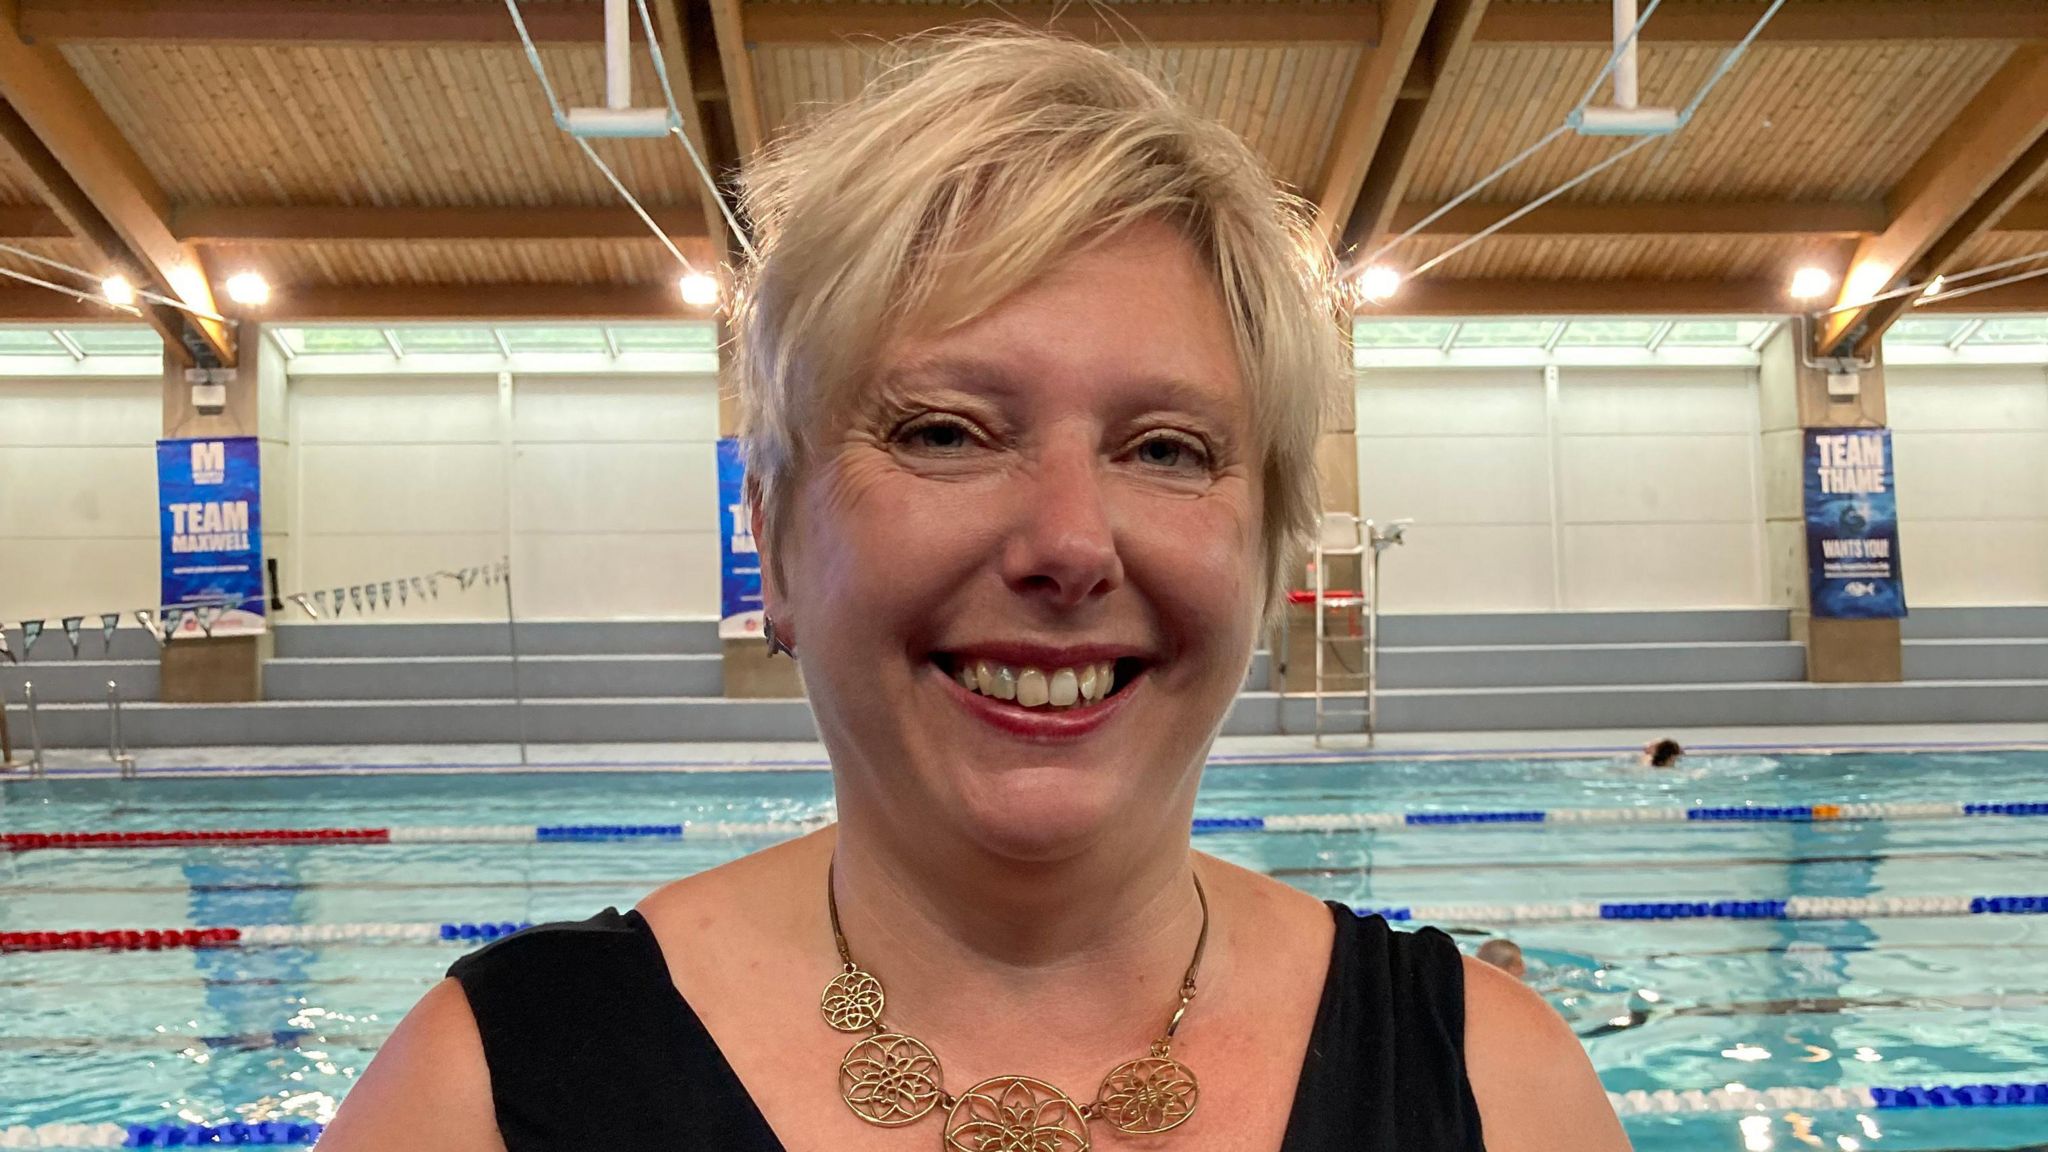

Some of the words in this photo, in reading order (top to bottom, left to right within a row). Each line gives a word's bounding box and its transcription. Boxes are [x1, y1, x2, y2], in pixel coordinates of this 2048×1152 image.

[191, 442, 225, 471] M
[1816, 435, 1884, 468] TEAM
[1818, 468, 1886, 494] THAME
[169, 501, 249, 532] TEAM
[172, 533, 250, 554] MAXWELL
[1822, 539, 1862, 558] WANTS
[1863, 539, 1890, 558] YOU!
